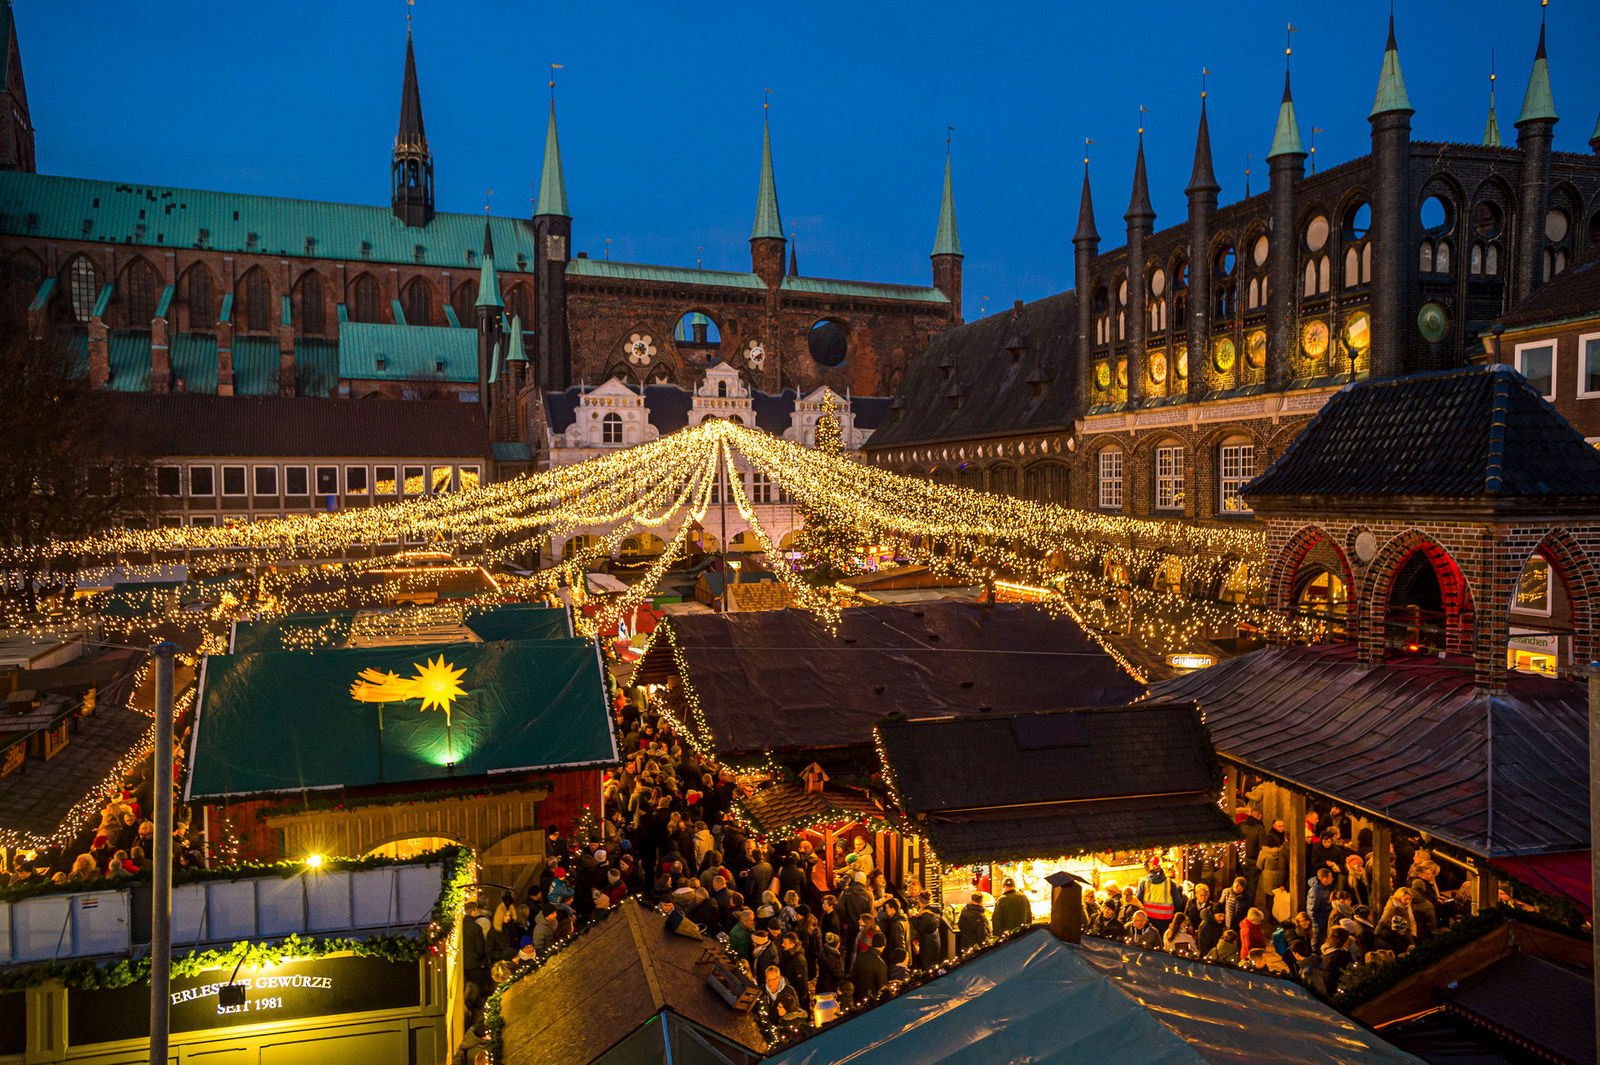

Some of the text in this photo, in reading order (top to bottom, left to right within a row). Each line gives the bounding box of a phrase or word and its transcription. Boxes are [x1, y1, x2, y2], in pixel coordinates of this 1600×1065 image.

[255, 974, 333, 989] GEWÜRZE
[216, 997, 283, 1015] SEIT 1981
